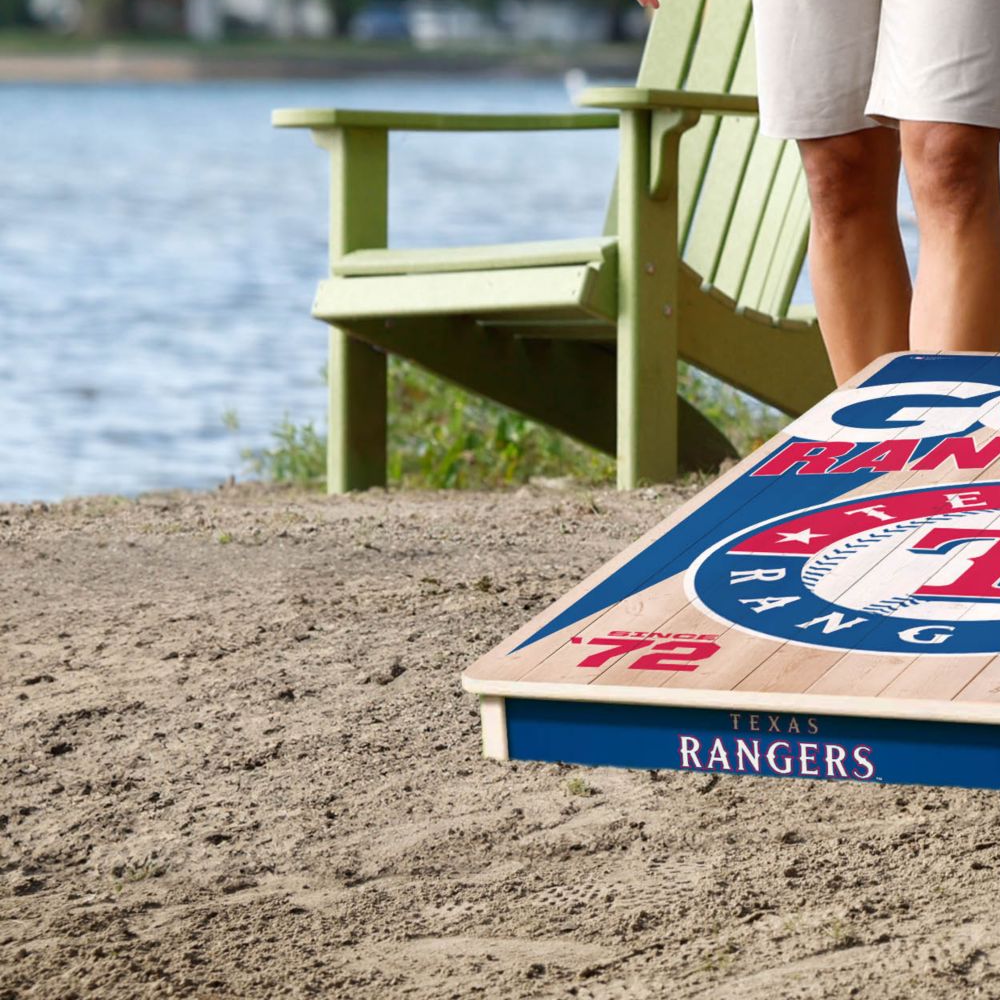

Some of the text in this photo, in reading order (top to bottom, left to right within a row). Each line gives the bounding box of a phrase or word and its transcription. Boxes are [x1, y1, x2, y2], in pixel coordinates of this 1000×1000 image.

[608, 630, 720, 641] SINCE
[730, 713, 819, 735] TEXAS
[678, 735, 876, 780] RANGERS
